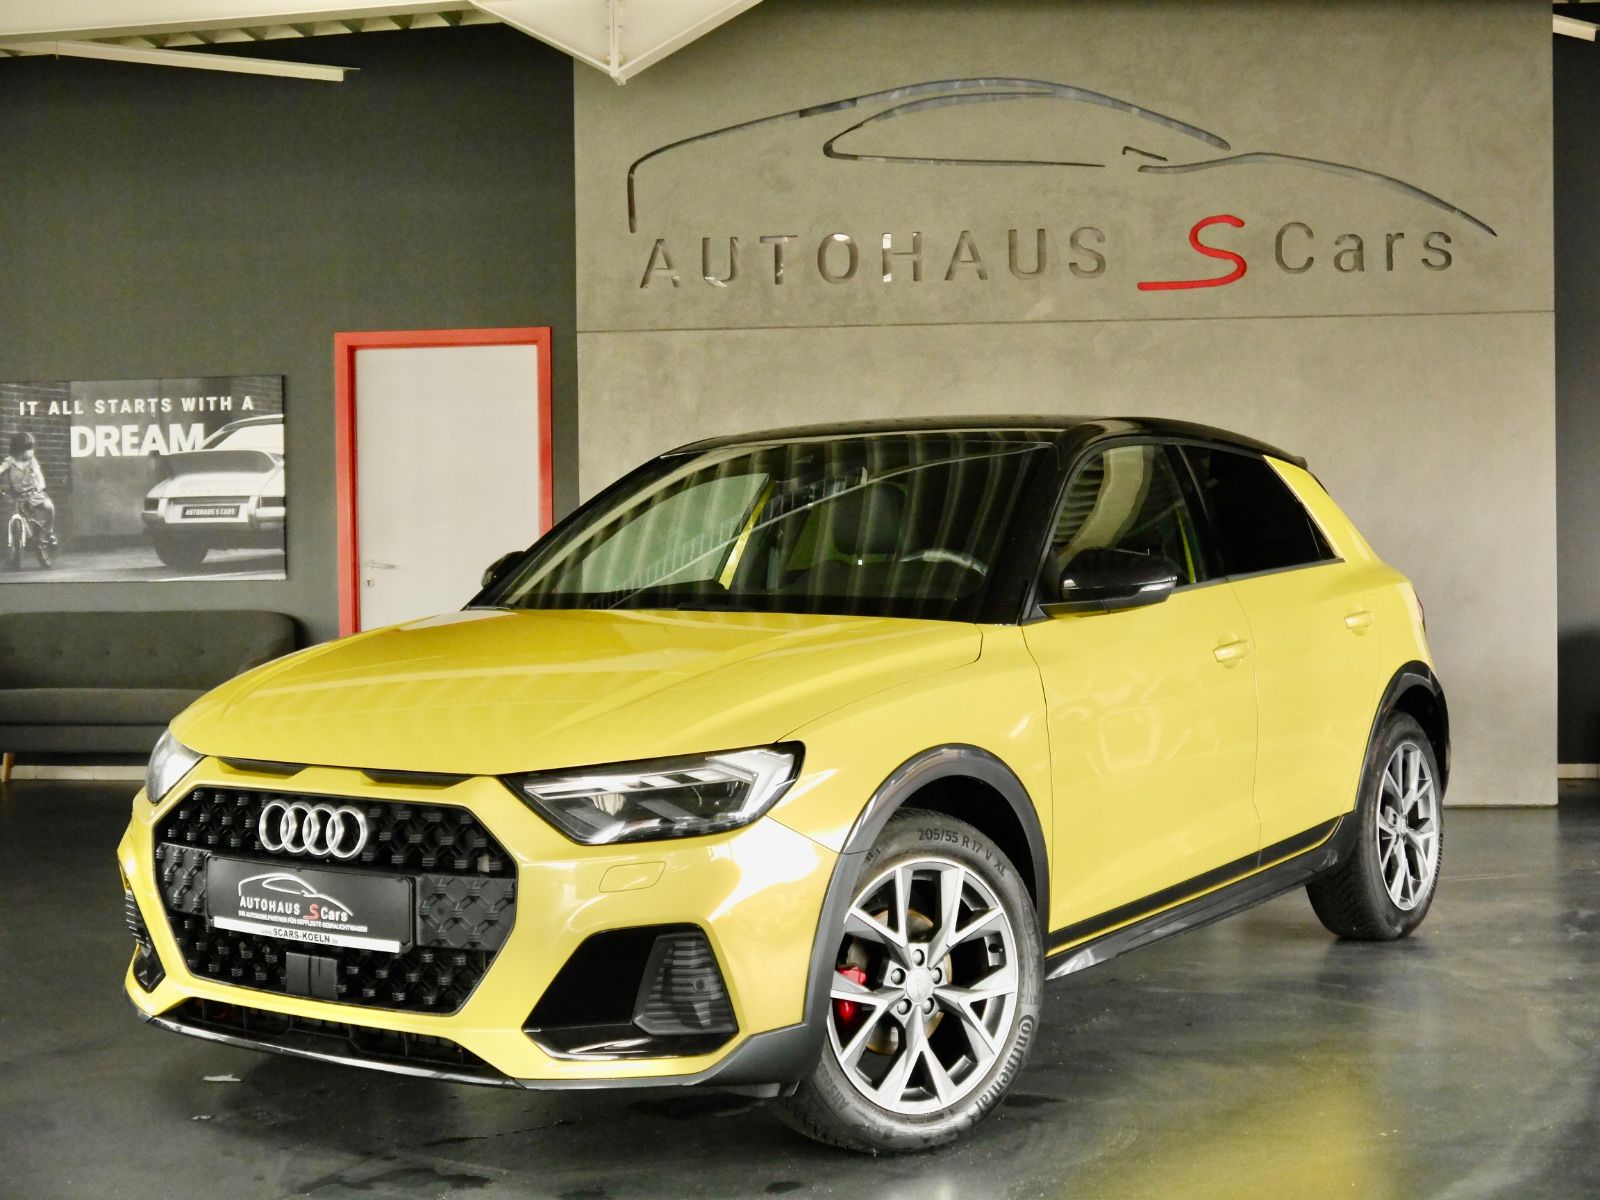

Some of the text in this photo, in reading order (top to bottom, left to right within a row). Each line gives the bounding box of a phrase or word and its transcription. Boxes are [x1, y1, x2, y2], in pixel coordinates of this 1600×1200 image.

[640, 214, 1452, 291] AUTOHAUS S Cars
[19, 395, 254, 416] IT ALL STARTS WITH A
[70, 423, 205, 458] DREAM
[917, 828, 1007, 877] 205/55 R 17 V XL
[240, 896, 349, 922] AUTOHAUS S Cars
